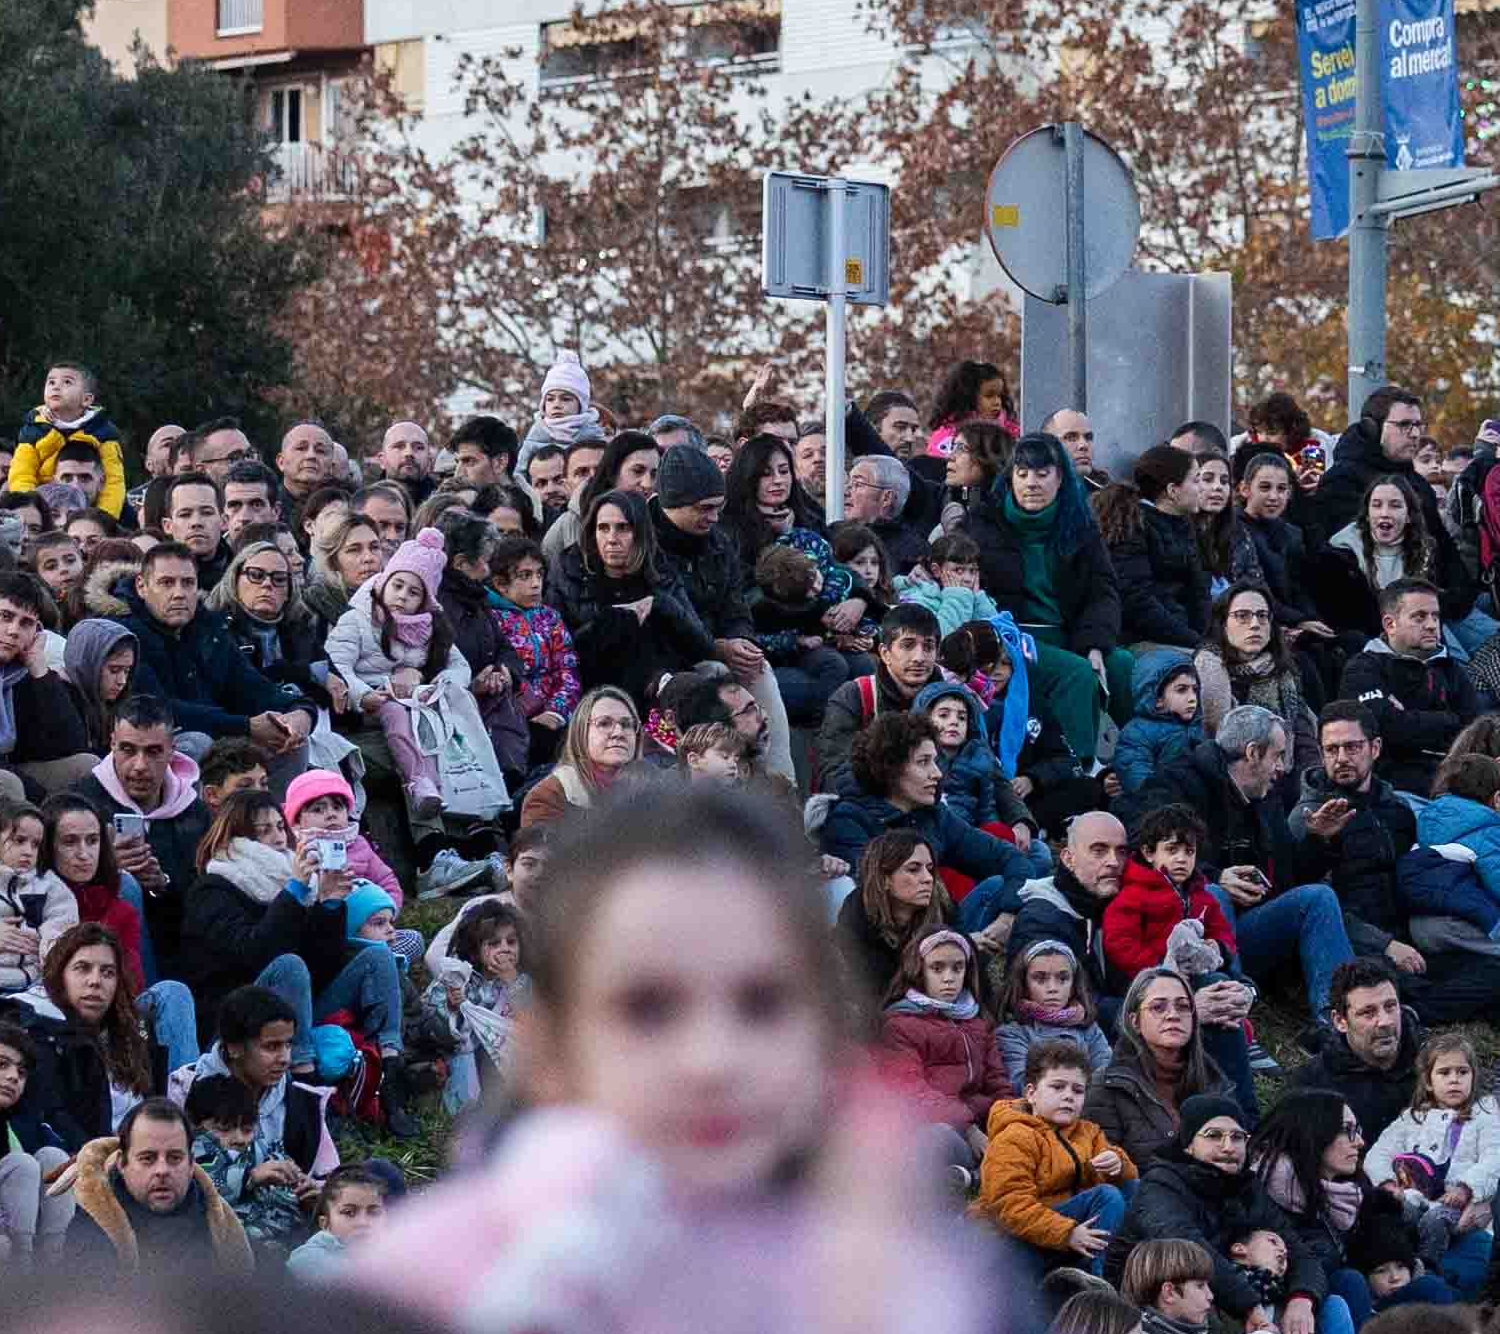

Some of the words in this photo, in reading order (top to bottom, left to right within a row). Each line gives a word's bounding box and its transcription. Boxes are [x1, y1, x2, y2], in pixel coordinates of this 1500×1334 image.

[1389, 17, 1444, 48] Compra
[1390, 48, 1407, 78] al
[1315, 86, 1327, 109] a
